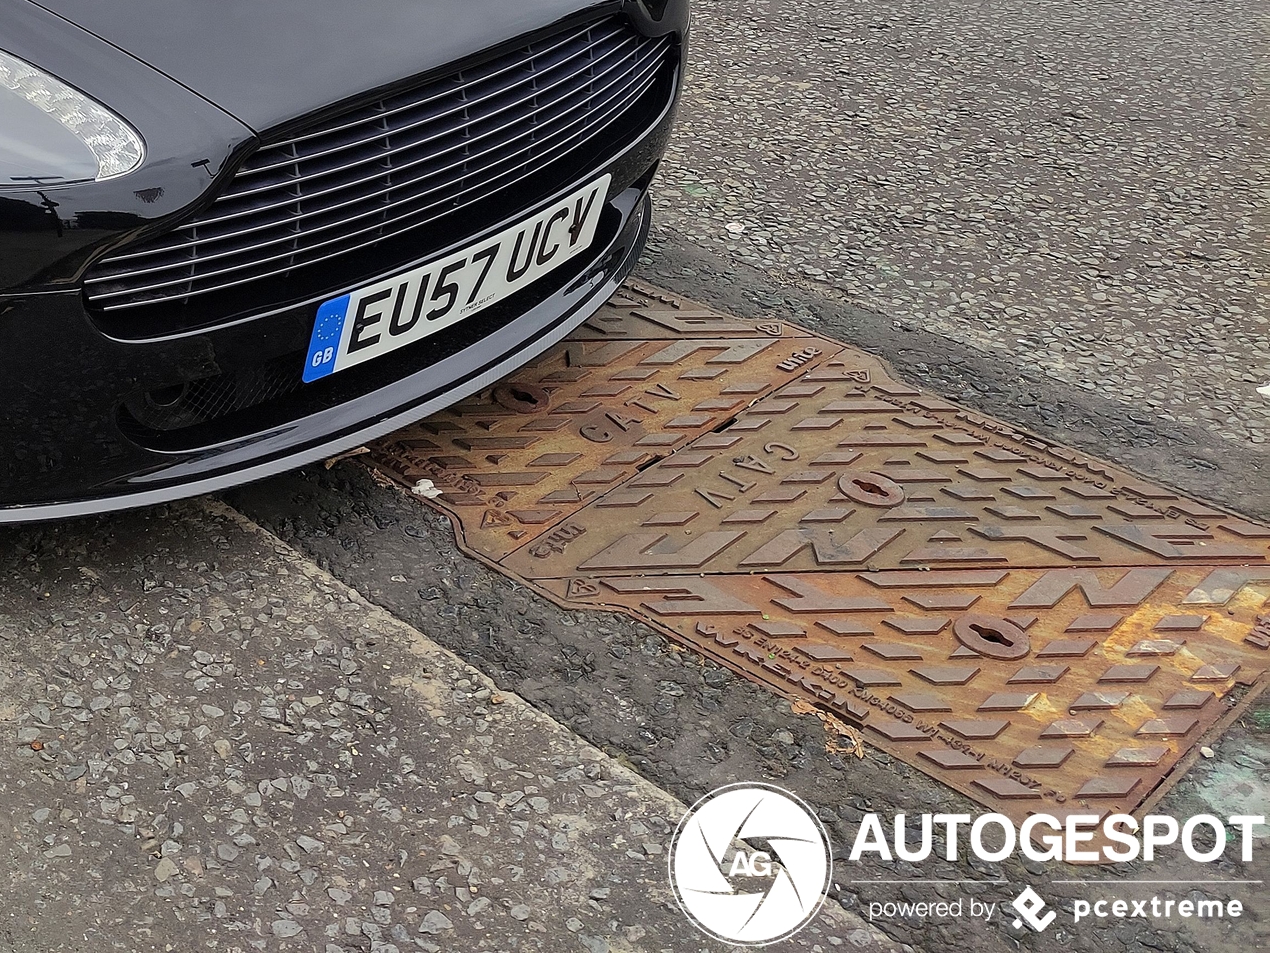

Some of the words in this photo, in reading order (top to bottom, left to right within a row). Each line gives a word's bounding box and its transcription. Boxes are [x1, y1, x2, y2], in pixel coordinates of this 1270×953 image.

[347, 242, 502, 355] EU57
[506, 189, 599, 283] UCV
[477, 292, 496, 306] SELECT
[312, 346, 334, 367] GB
[580, 383, 681, 443] CATV
[694, 441, 800, 509] CATV
[695, 621, 871, 721] WREKIN
[732, 625, 755, 640] BS
[753, 637, 811, 671] EN124-2
[811, 664, 849, 689] D400
